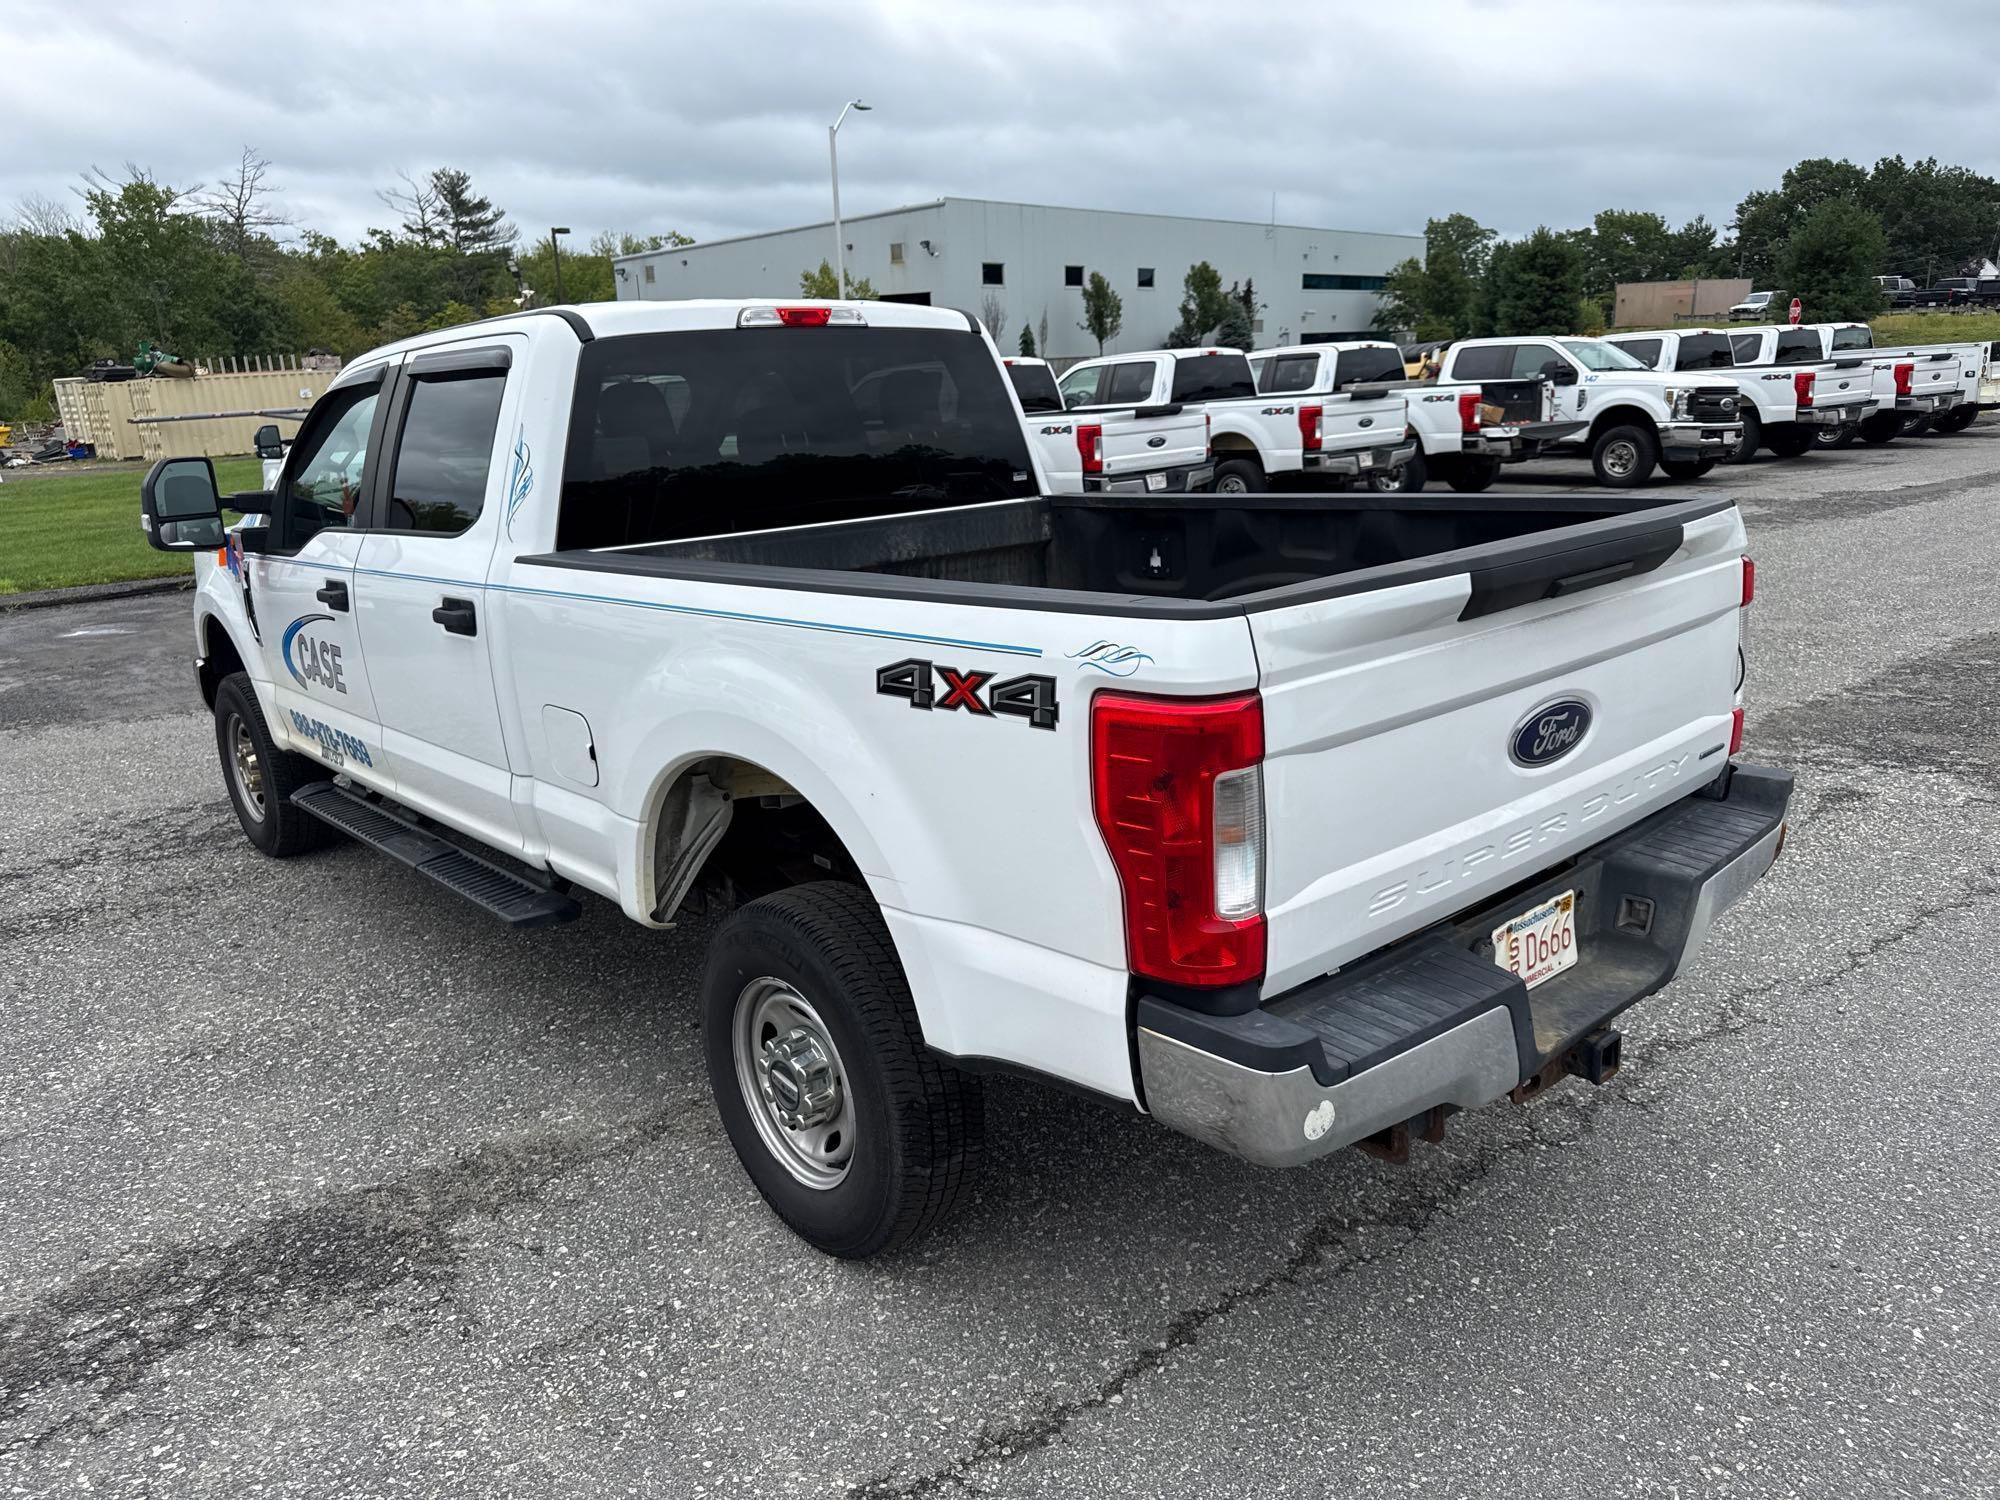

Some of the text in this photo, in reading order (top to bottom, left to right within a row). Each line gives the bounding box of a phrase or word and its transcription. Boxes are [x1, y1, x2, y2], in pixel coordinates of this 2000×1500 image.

[297, 633, 348, 695] CASE
[1533, 711, 1578, 757] Ford
[1368, 751, 1689, 918] SUPER DUTY
[1526, 911, 1572, 971] D666
